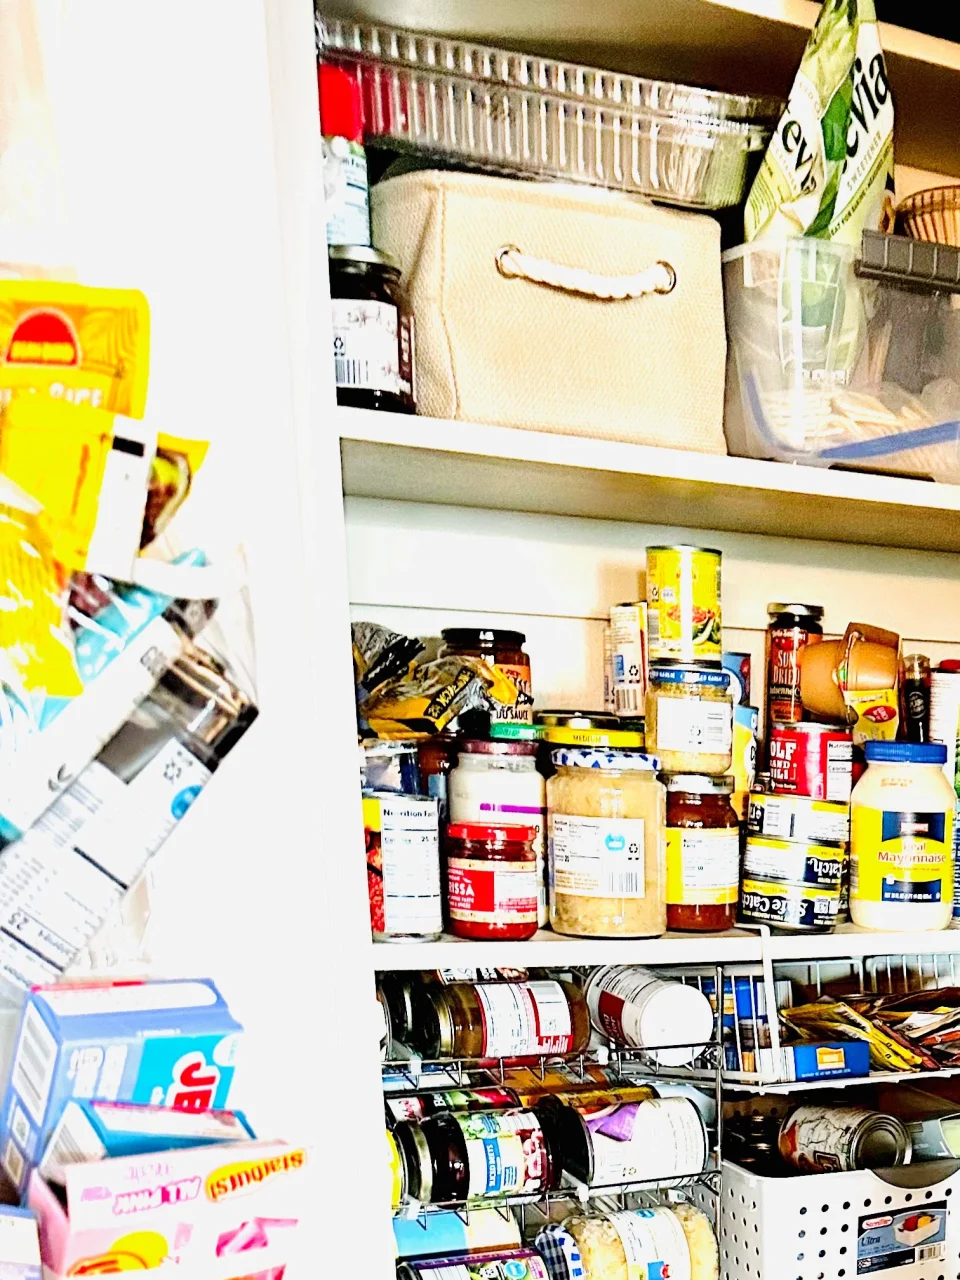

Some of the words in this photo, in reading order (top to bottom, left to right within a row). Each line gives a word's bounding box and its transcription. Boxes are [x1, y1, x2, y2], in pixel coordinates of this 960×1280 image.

[847, 130, 882, 192] SWEETENER
[877, 850, 947, 866] Mayonnaise
[861, 1235, 881, 1247] Ultra
